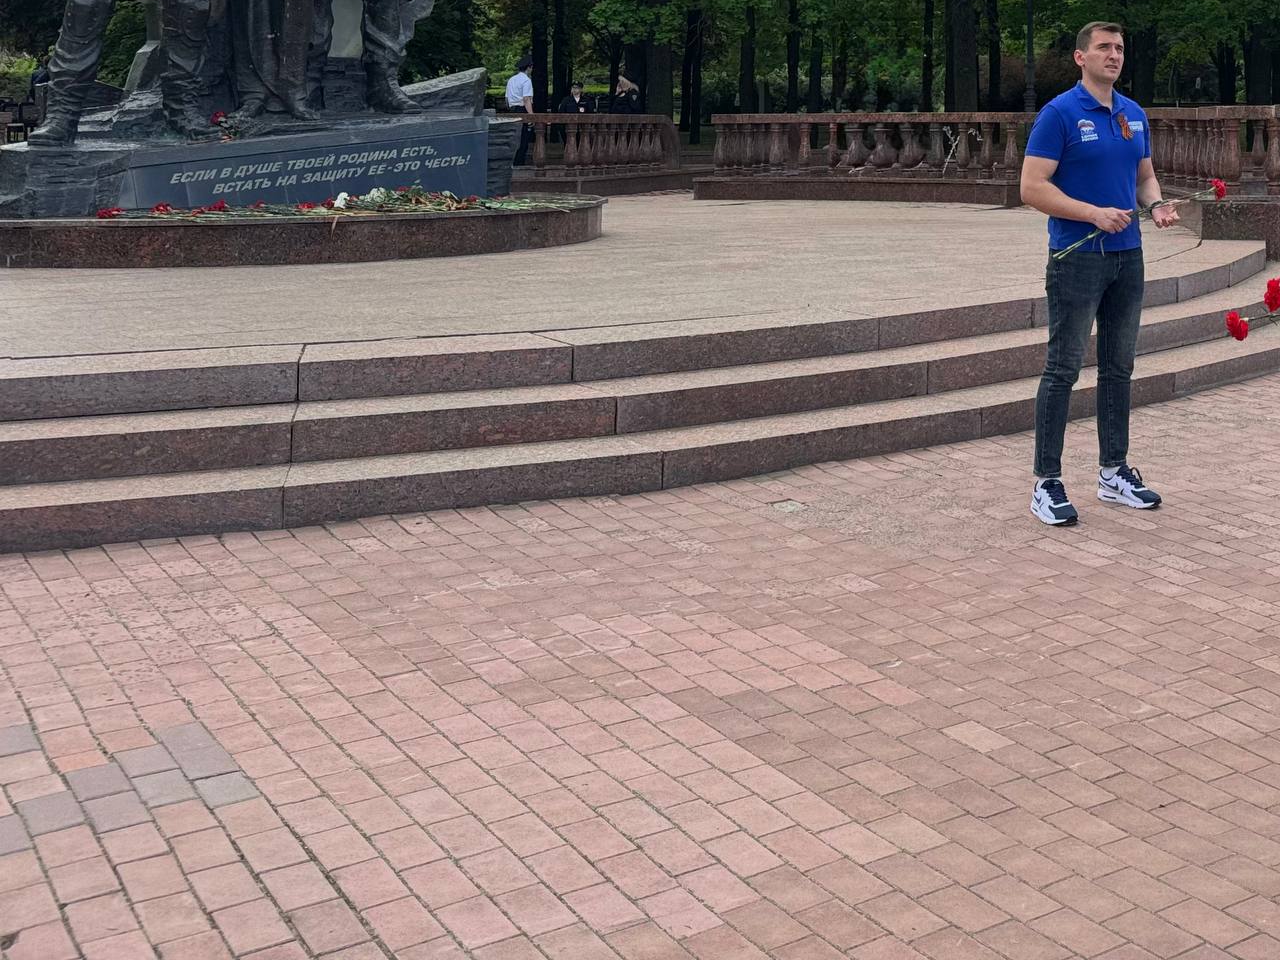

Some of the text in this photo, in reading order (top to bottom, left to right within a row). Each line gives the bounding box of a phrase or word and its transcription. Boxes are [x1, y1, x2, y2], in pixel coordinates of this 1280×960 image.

[170, 145, 438, 184] ЕСЛИ В ДУШЕ ТВОЕЙ РОДИНА ЕСТЬ,
[212, 178, 272, 194] ВСТАТЬ
[275, 174, 297, 187] НА
[301, 166, 365, 184] ЗАЩИТУ
[424, 155, 471, 169] ЧЕСТЬ!
